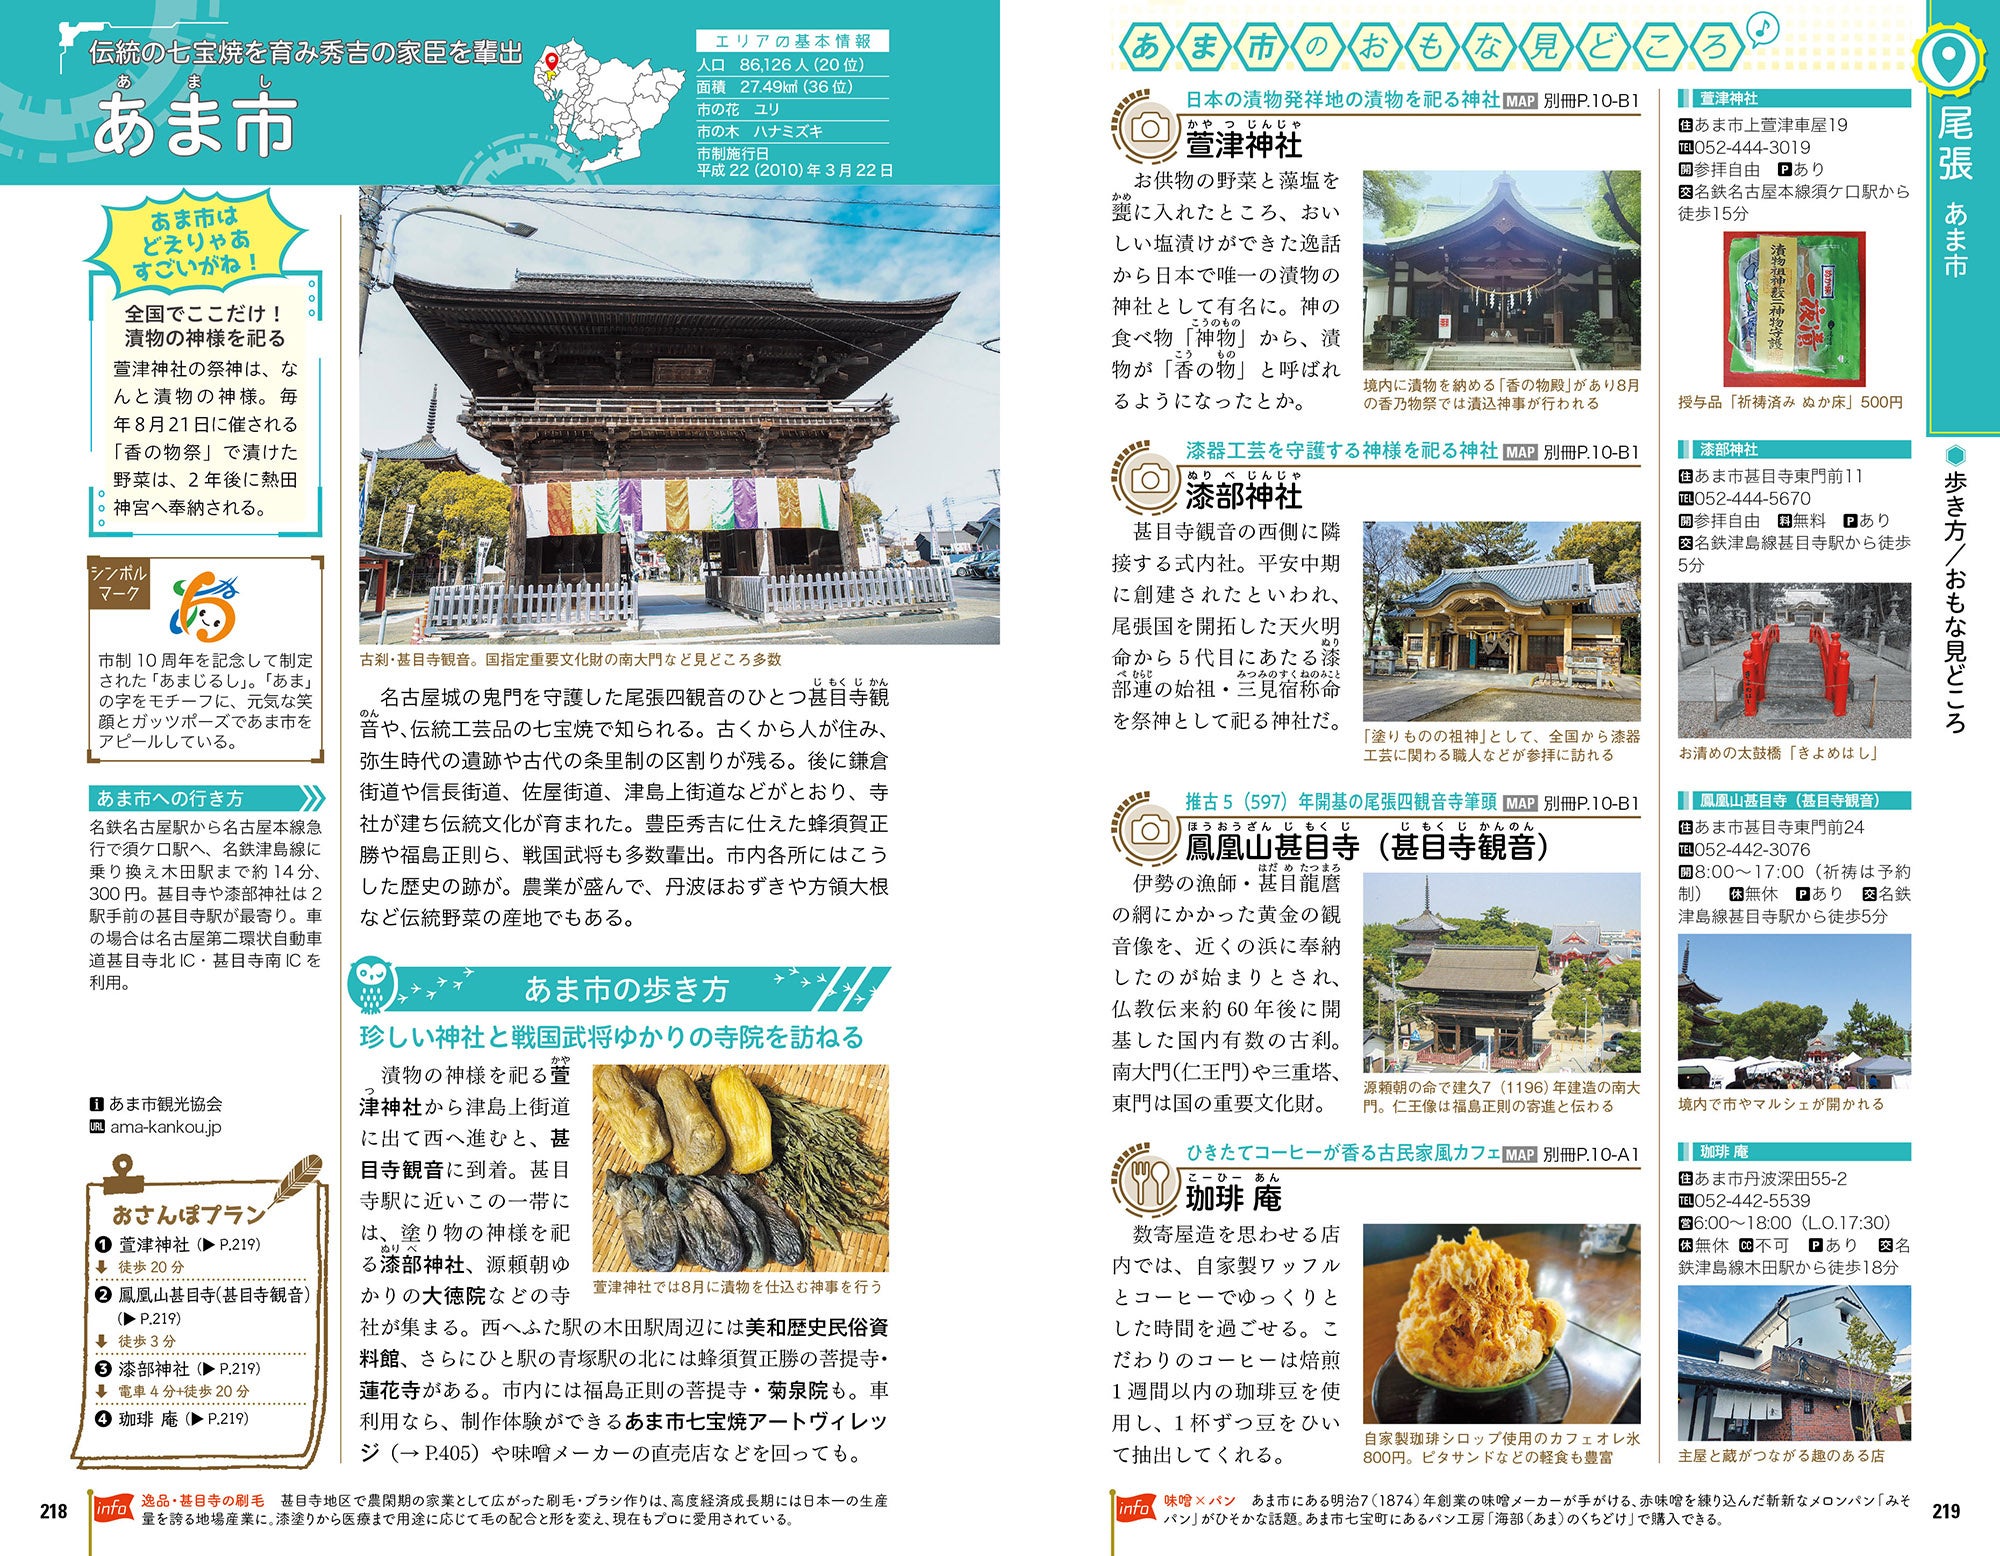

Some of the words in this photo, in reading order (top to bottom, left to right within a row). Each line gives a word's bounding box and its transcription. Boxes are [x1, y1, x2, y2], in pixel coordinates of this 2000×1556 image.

[717, 34, 870, 48] エリアの基本情報
[698, 58, 724, 71] 人口
[696, 79, 726, 96] 面積
[1507, 94, 1536, 106] MAP
[1701, 90, 1759, 107] 萱津神社
[698, 103, 739, 116] 市の花
[755, 103, 778, 116] ユリ
[94, 88, 298, 158] あま市
[697, 125, 739, 138] 市の木
[754, 124, 822, 138] ハナミズキ
[1187, 131, 1302, 159] 萱津神社
[1939, 106, 1972, 179] 尾張
[698, 147, 768, 160] 市制施行日
[1134, 171, 1339, 190] お供物の野菜と藻塩を
[152, 206, 240, 232] あま市は
[1678, 206, 1749, 221] 徒歩15分
[142, 228, 254, 257] どえりゃあ
[1116, 234, 1341, 253] しい塩漬けができた逸話
[1944, 202, 1968, 278] あま市
[132, 253, 257, 282] すごいがね！
[1114, 265, 1339, 285] から日本で唯一の漬物の
[125, 304, 279, 323] 全国でここだけ！
[1113, 297, 1339, 316] 神社として有名に。神の
[125, 329, 284, 348] 漬物の神様を祀る
[114, 360, 297, 378] 萱津神社の祭神は、な
[1112, 360, 1341, 380] 物が「香の物」と呼ばれ
[114, 387, 297, 405] んと漬物の神様。毎
[1115, 392, 1302, 411] るようになったとか。
[114, 416, 297, 433] 年8月21日に催される
[116, 443, 297, 461] 「香の物祭」で漬けた
[1507, 445, 1534, 457] MAP
[1700, 441, 1758, 458] 漆部神社
[114, 471, 296, 488] 野菜は、2年後に熱田
[1186, 482, 1302, 510] 漆部神社
[114, 499, 263, 516] 神宮へ奉納される。
[1133, 522, 1340, 541] 甚目寺観音の西側に隣
[92, 564, 147, 580] シンボル
[1112, 554, 1339, 573] 接する式内社。平安中期
[99, 586, 139, 601] マーク
[1114, 585, 1338, 604] に創建されたといわれ、
[1112, 617, 1339, 636] 尾張国を開拓した天火明
[99, 652, 312, 668] 市制10周年を記念して制定
[100, 693, 312, 709] の字をモチーフに、元気な笑
[99, 713, 311, 730] 顔とガッツポーズであま市を
[1114, 711, 1338, 731] を祭神として祀る神社だ。
[100, 733, 235, 749] アピールしている。
[98, 790, 243, 807] あま市への行き方
[1507, 796, 1536, 809] MAP
[90, 819, 322, 835] 名鉄名古屋駅から名古屋本線急
[1113, 905, 1341, 924] の網にかかった黄金の観
[1679, 908, 1888, 924] 津島線甚目寺駅から徒歩5分
[90, 930, 322, 946] の場合は名古屋第二環状自動車
[1112, 937, 1340, 956] 音像を、近くの浜に奉納
[90, 975, 128, 990] 利用。
[1115, 968, 1338, 987] したのが始まりとされ、
[526, 976, 729, 1003] あま市の歩き方
[1112, 999, 1340, 1019] 仏教伝来約60年後に開
[1112, 1030, 1339, 1050] 基した国内有数の古刹。
[110, 1096, 222, 1112] あま市観光協会
[1112, 1093, 1322, 1113] 東門は国の重要文化財。
[1678, 1097, 1883, 1111] 境内で市やマルシェが開かれる
[111, 1120, 221, 1137] ama-kankou.jp
[362, 1128, 570, 1148] に出て西へ進むと、甚
[1505, 1147, 1536, 1160] MAP
[362, 1160, 567, 1180] 目寺観音に到着。甚目
[360, 1191, 569, 1211] 寺駅に近いこの一帯に
[113, 1204, 266, 1225] おさんぽプラン
[362, 1223, 570, 1242] は、塗り物の神様を祀
[1133, 1225, 1340, 1244] 数寄屋造を思わせる店
[120, 1236, 190, 1253] 萱津神社
[119, 1260, 184, 1274] 徒歩20分
[1113, 1256, 1340, 1275] 内では、自家製ワッフル
[1679, 1260, 1899, 1275] 鉄津島線木田駅から徒歩18分
[361, 1286, 570, 1305] かりの大徳院などの寺
[1116, 1288, 1337, 1306] とコーヒーでゆっくりと
[1116, 1319, 1337, 1338] した時間を過ごせる。こ
[119, 1334, 176, 1348] 徒歩3分
[119, 1360, 190, 1378] 漆部神社
[1114, 1350, 1340, 1370] だわりのコーヒーは焙煎
[1113, 1382, 1340, 1401] 1週間以内の珈琲豆を使
[1112, 1413, 1339, 1433] 用し、1杯ずつ豆をひい
[1113, 1445, 1282, 1464] て抽出してくれる。
[1679, 1449, 1885, 1463] 主屋と蔵がつながる趣のある店
[96, 1499, 128, 1517] info
[142, 1494, 264, 1507] 逸品・甚目寺の刷毛
[1119, 1500, 1150, 1516] info
[40, 1504, 67, 1519] 218
[1933, 1504, 1960, 1519] 219
